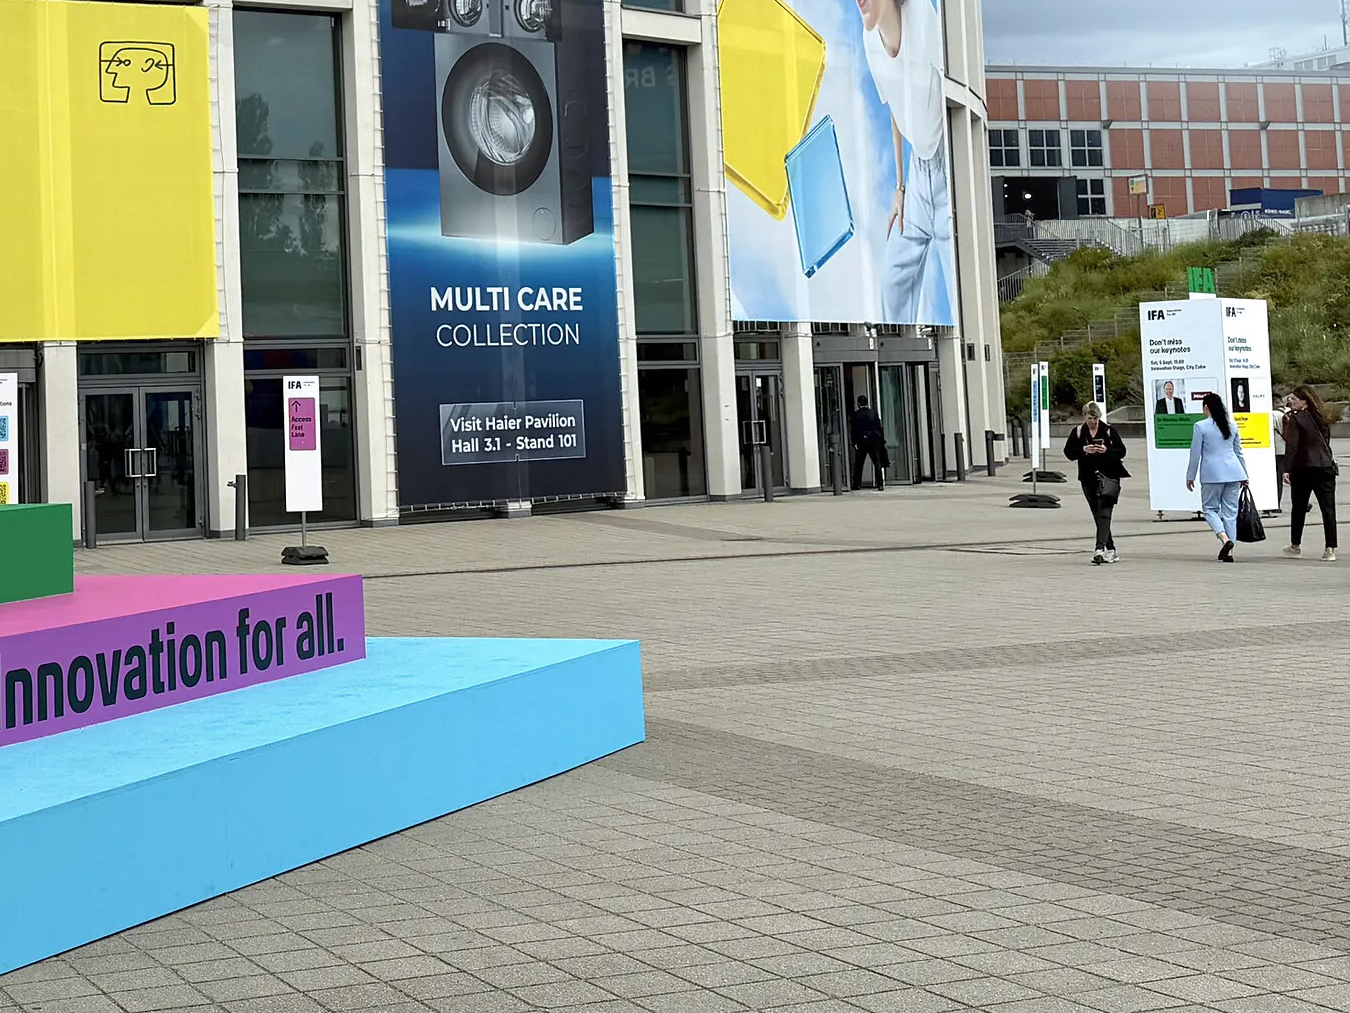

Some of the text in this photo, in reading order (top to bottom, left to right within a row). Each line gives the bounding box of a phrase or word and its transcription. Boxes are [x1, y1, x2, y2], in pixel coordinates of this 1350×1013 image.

[430, 286, 583, 312] MULTI CARE
[1147, 309, 1165, 320] IFA
[436, 323, 580, 347] COLLECTION
[288, 381, 302, 389] IFA
[450, 412, 576, 432] Visit Haier Pavilion
[451, 438, 479, 453] Hall
[484, 437, 501, 452] 3.1
[516, 434, 554, 451] Stand
[558, 433, 577, 448] 101
[237, 607, 287, 676] for
[295, 592, 345, 660] all.
